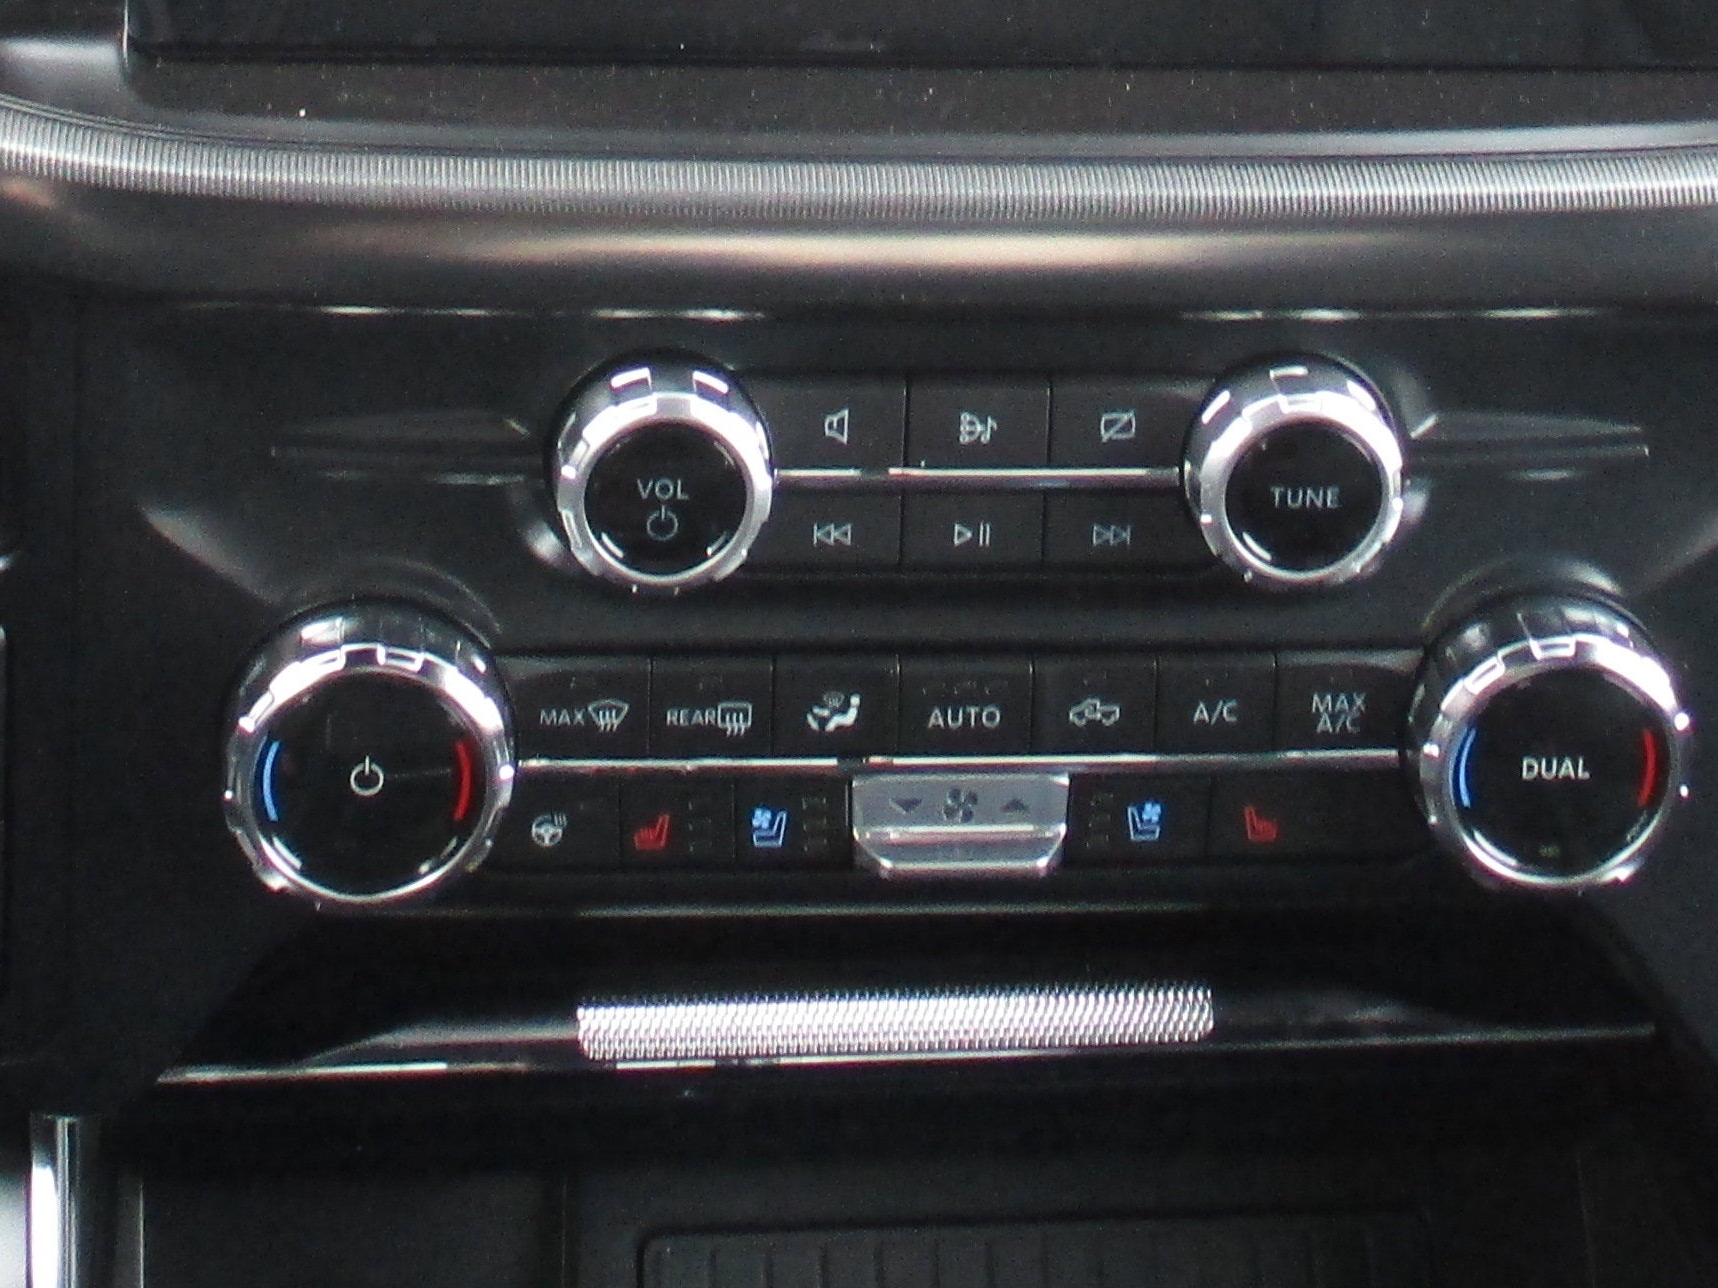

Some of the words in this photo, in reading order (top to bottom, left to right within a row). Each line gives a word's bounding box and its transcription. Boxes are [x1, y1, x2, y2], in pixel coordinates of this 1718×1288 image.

[636, 479, 689, 501] VOL
[1270, 486, 1341, 510] TUNE
[1193, 700, 1239, 725] A/C
[1310, 692, 1367, 714] MAX
[539, 707, 586, 726] MAX
[666, 708, 716, 726] REAR
[927, 706, 1002, 729] AUTO
[1315, 712, 1361, 735] A/C
[1521, 756, 1591, 781] DUAL
